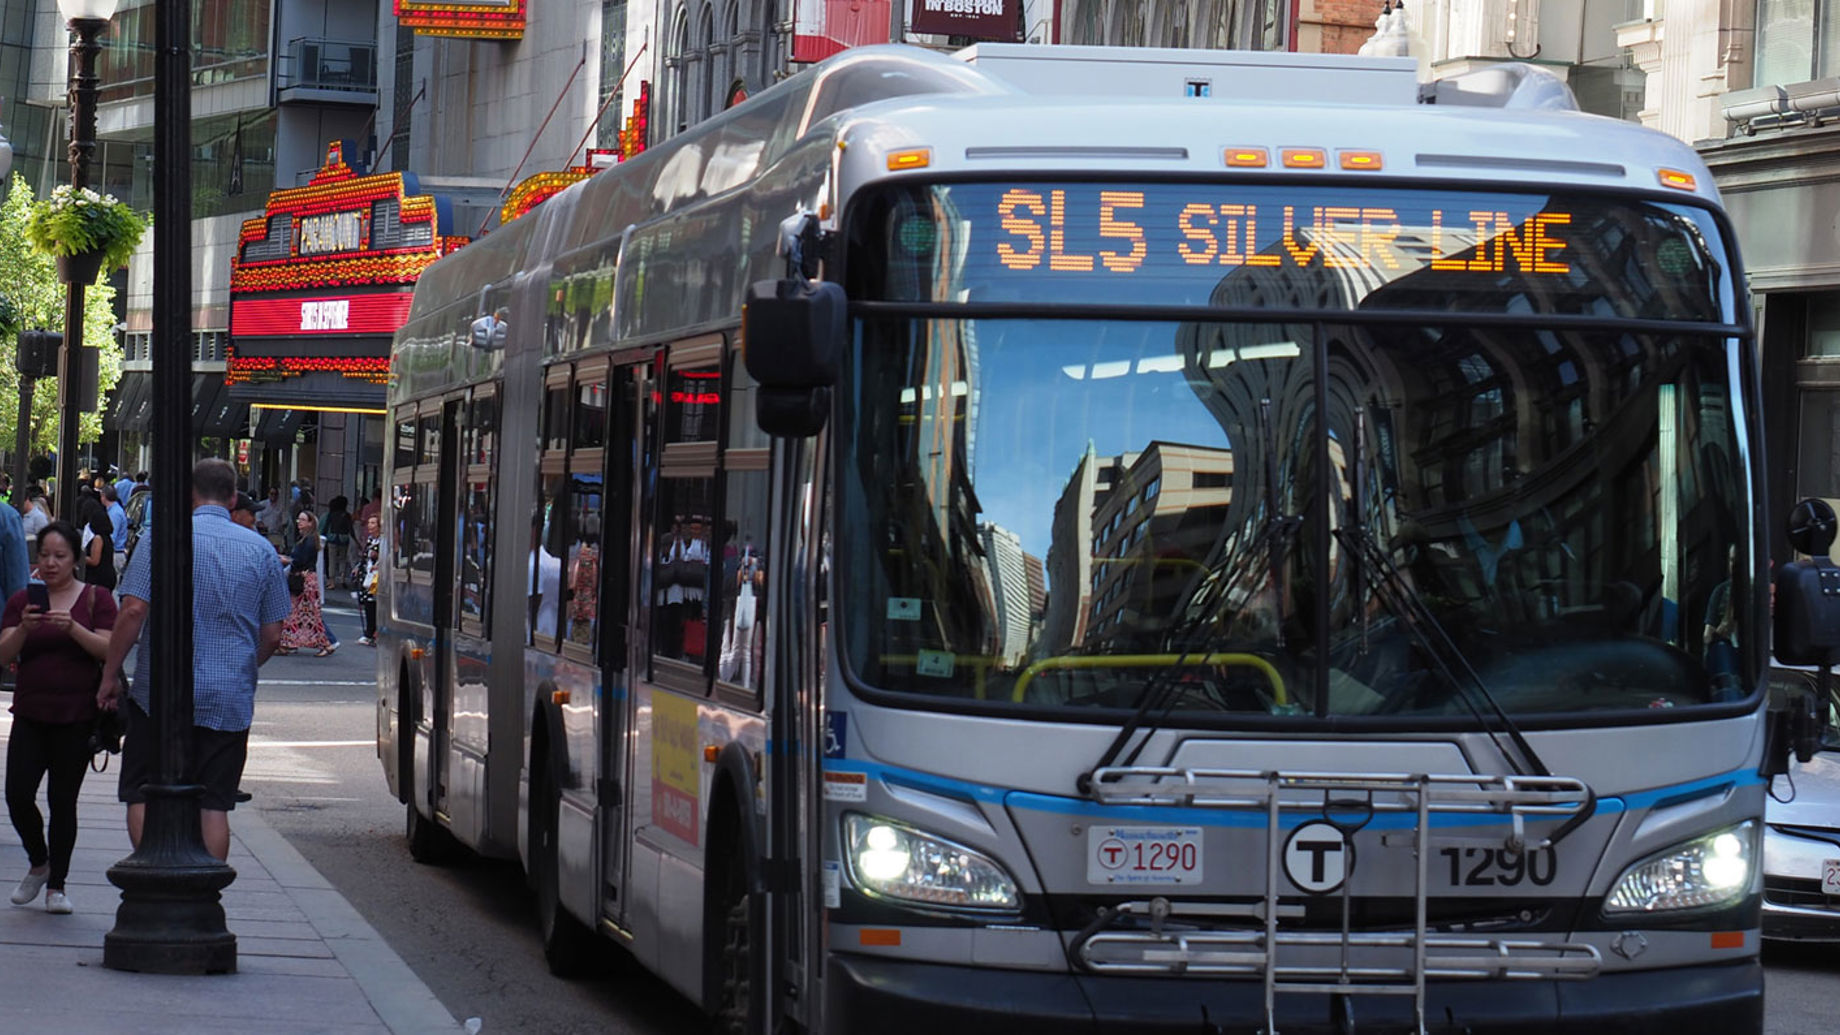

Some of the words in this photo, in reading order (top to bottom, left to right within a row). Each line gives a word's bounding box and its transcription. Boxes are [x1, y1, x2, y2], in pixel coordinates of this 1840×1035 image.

[925, 0, 942, 11] IN
[943, 1, 1003, 15] BOSTON
[1187, 81, 1209, 97] T
[997, 188, 1147, 272] SL5
[1178, 203, 1401, 269] SILVER
[1430, 210, 1572, 273] LINE
[1103, 847, 1123, 864] T
[1132, 842, 1197, 871] 1290
[1296, 840, 1342, 883] T
[1440, 847, 1558, 886] 1290
